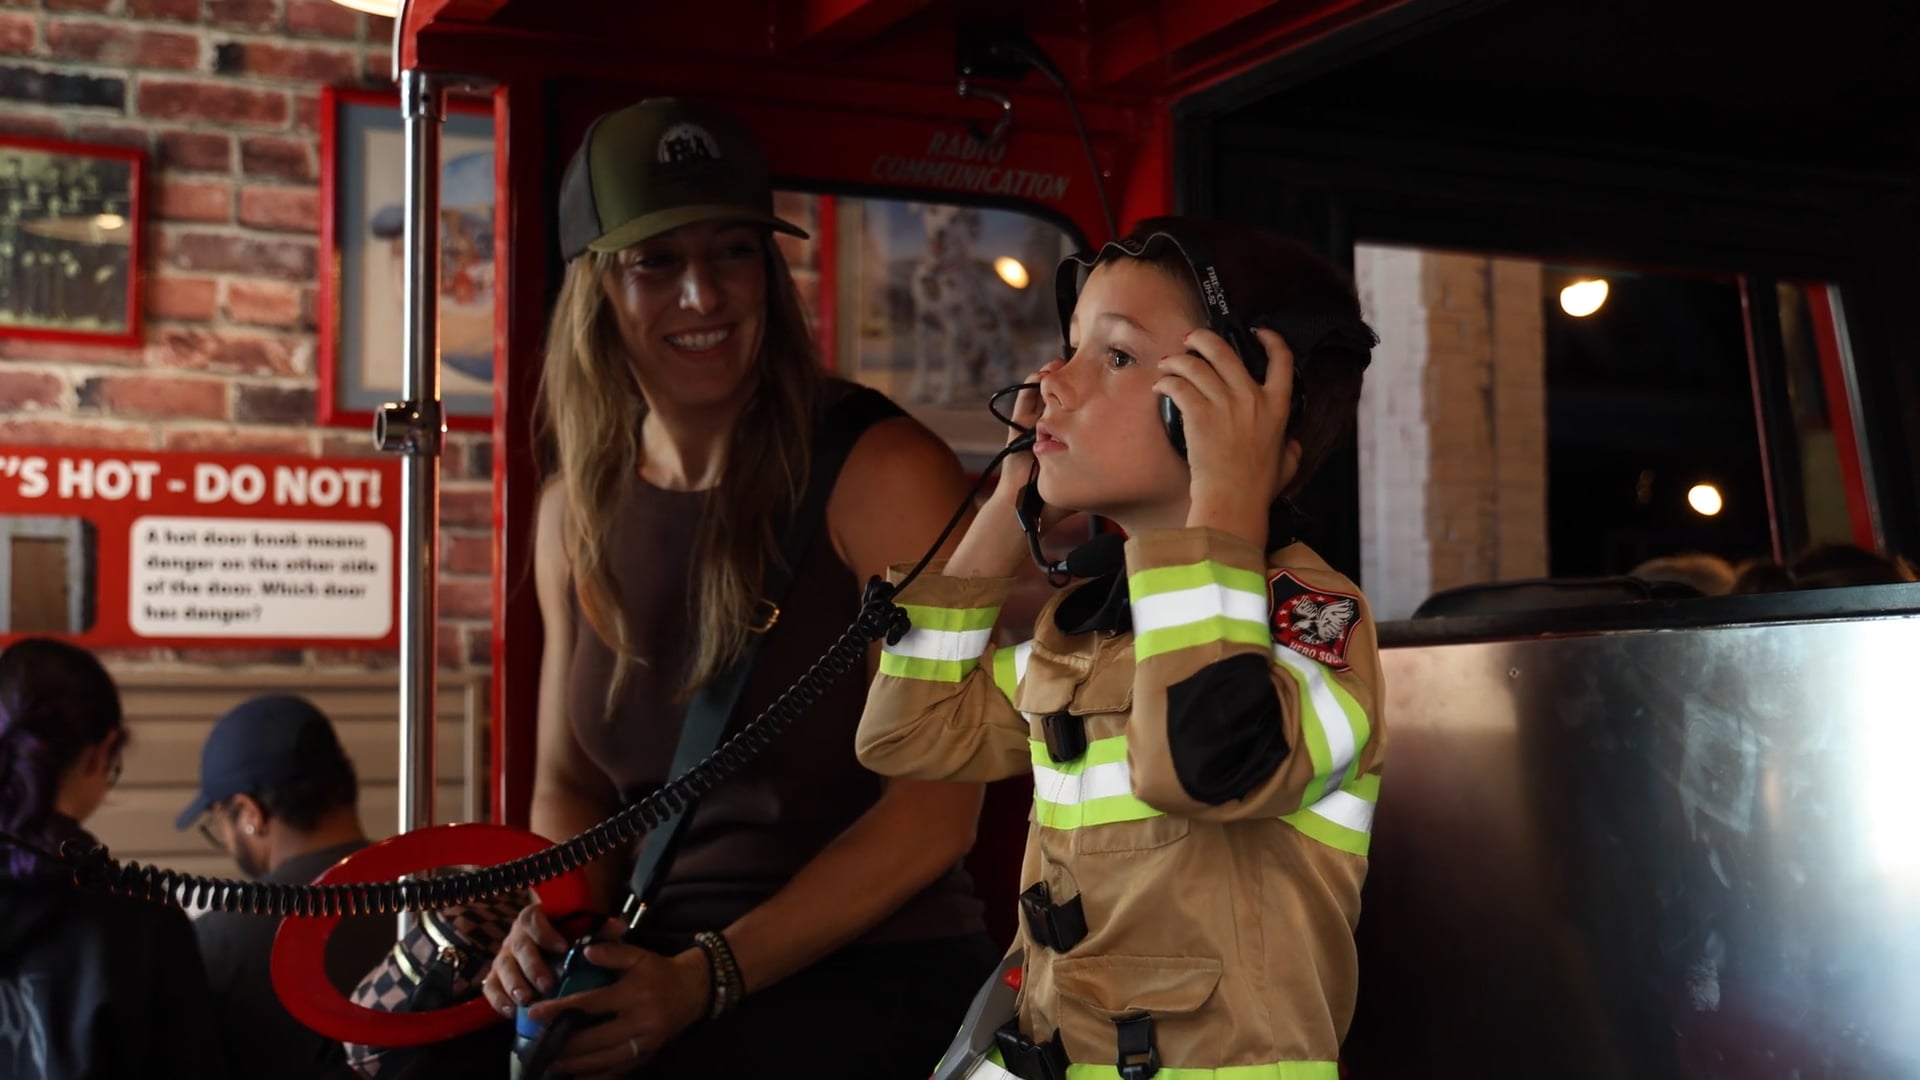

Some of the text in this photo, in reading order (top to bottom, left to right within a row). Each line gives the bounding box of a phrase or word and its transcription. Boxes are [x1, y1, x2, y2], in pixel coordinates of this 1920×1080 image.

[928, 130, 1006, 162] RADIO
[872, 153, 1070, 200] COMMUNICATION
[58, 459, 160, 500] HOT
[194, 464, 266, 504] DO
[275, 467, 382, 508] NOT!
[147, 531, 366, 549] A hot door knob means
[147, 556, 377, 573] danger on the other side
[147, 581, 164, 595] of
[171, 582, 199, 596] the
[261, 582, 316, 598] Which
[324, 584, 366, 598] door
[146, 605, 262, 624] has danger?
[1289, 641, 1316, 657] HERO
